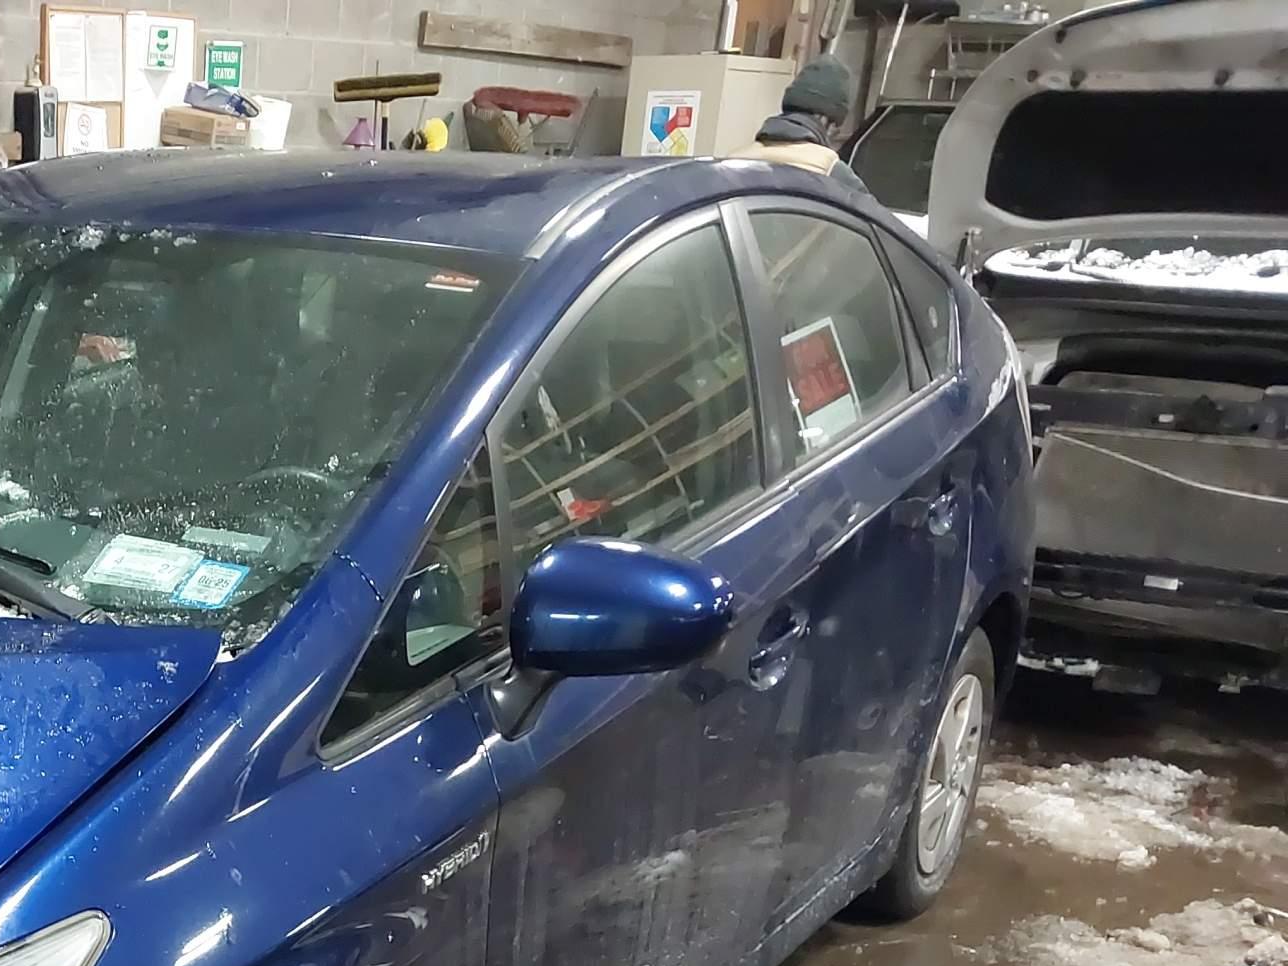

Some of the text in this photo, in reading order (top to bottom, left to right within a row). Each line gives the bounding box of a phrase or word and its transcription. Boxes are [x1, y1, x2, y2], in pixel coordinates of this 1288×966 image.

[211, 51, 239, 64] EYE WASH
[213, 67, 237, 80] STATION
[421, 841, 482, 895] HYBRID
